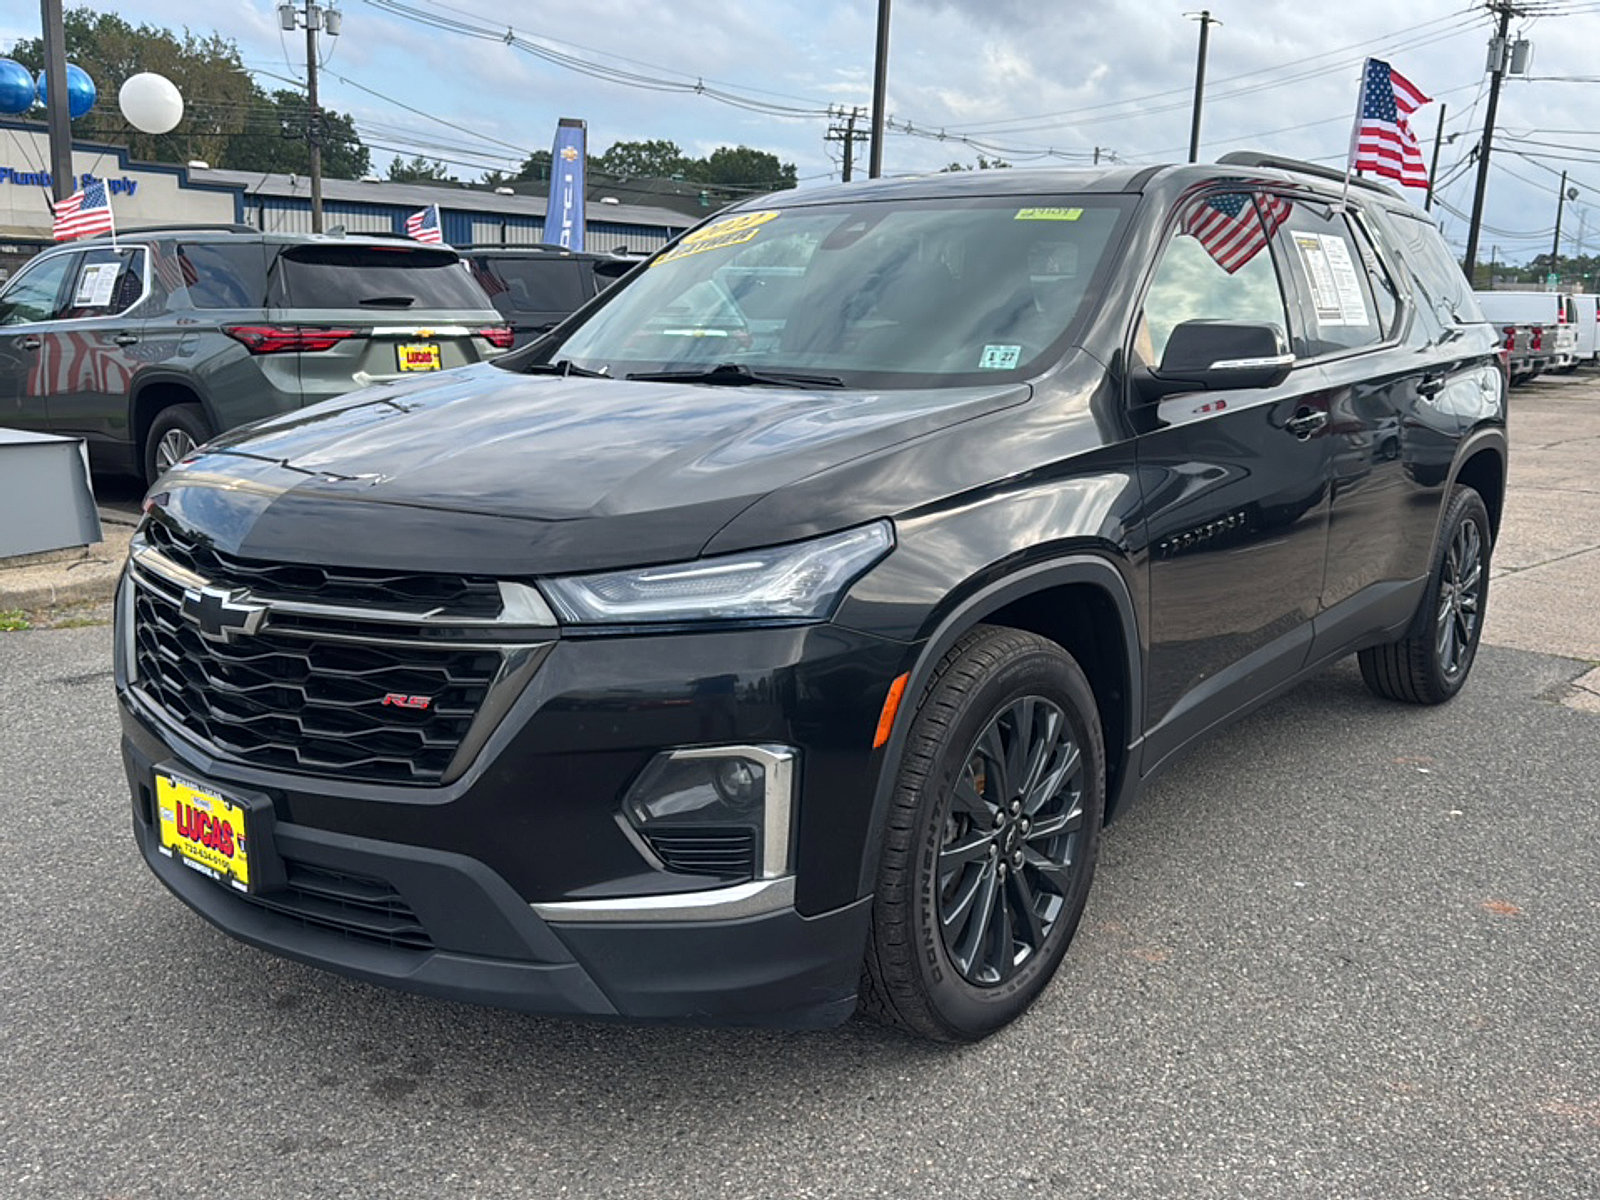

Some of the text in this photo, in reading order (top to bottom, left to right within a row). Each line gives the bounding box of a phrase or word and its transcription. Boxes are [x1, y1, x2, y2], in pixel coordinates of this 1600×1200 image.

[0, 167, 77, 191] Plumb
[381, 693, 432, 710] RS
[176, 800, 234, 859] LUCAS
